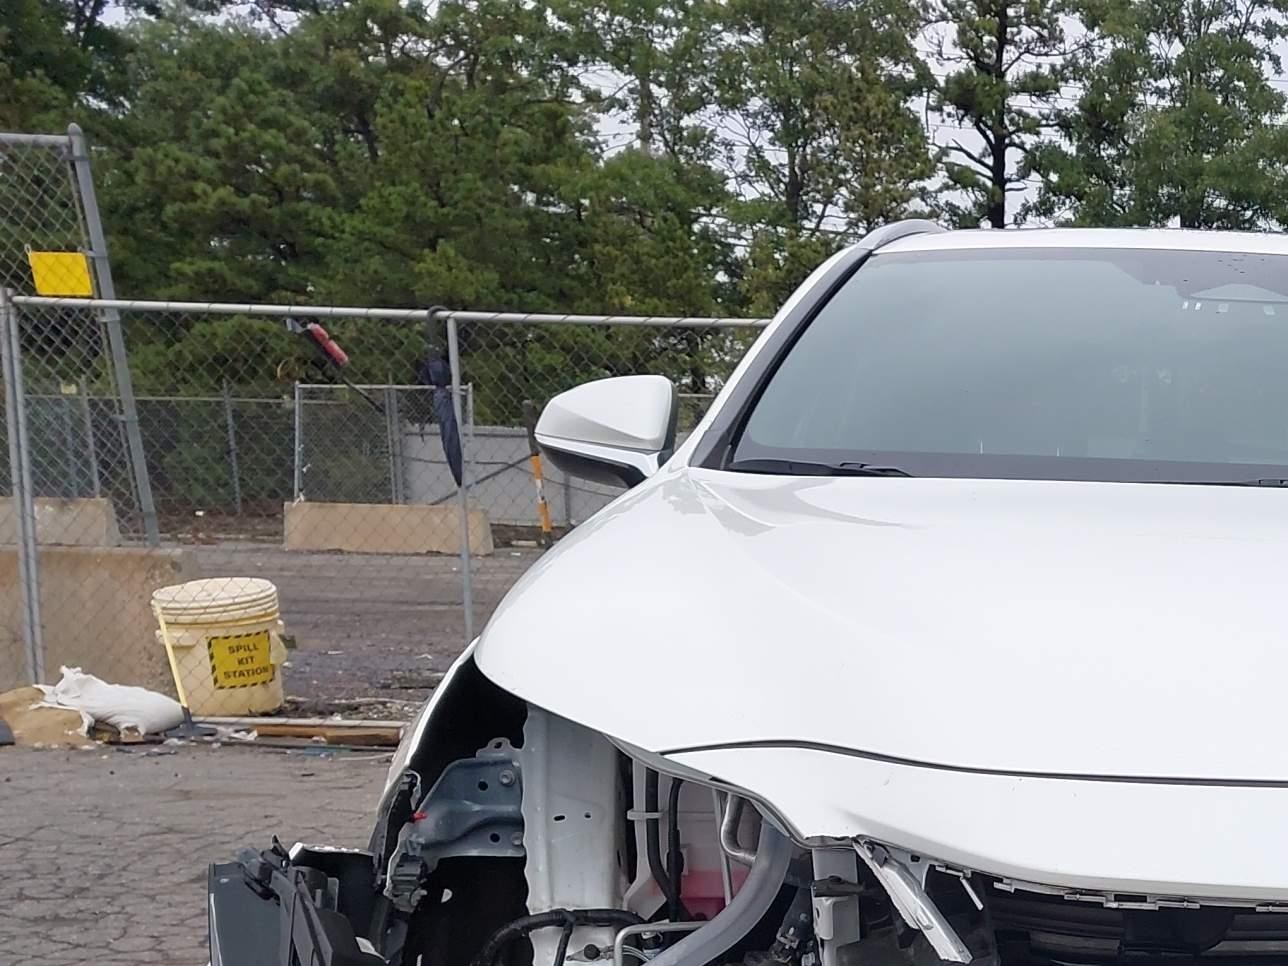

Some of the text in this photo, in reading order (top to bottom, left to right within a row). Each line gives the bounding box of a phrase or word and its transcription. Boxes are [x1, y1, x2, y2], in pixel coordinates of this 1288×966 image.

[228, 643, 259, 654] SPILL
[237, 656, 255, 666] KIT
[224, 666, 269, 680] STATION
